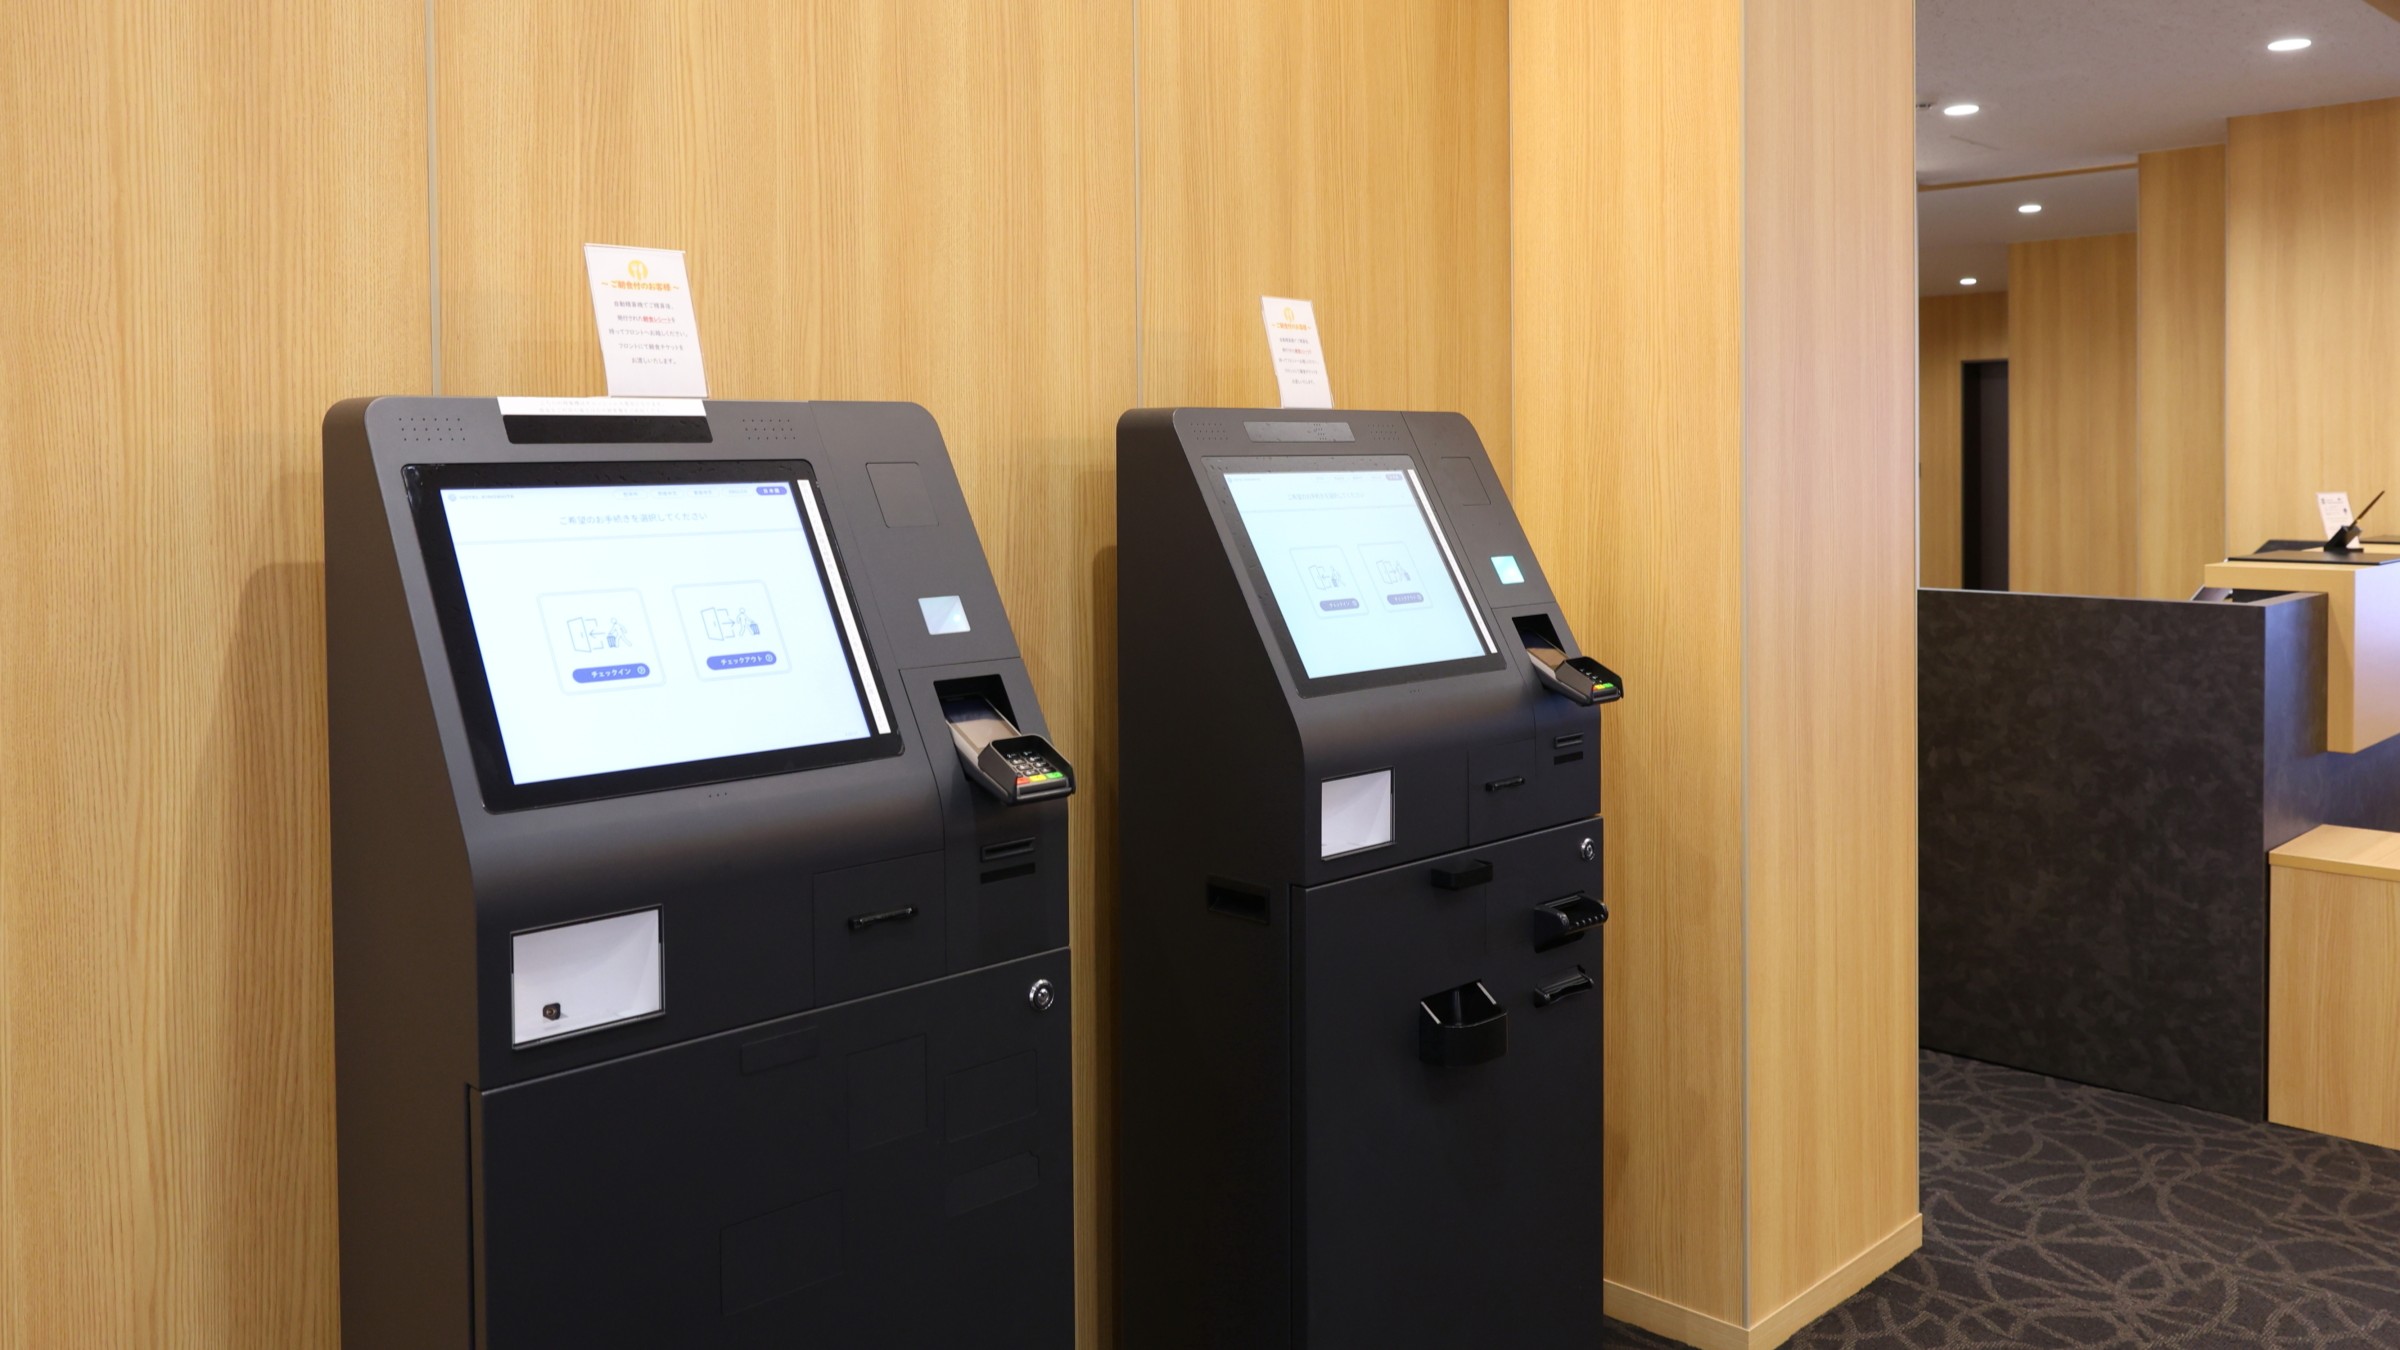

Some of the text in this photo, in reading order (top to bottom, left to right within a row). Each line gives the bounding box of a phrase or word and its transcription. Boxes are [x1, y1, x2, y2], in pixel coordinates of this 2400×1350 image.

[559, 512, 708, 526] ご希望のお手続きを選択してください
[720, 655, 763, 666] チェックアウト
[591, 668, 632, 678] チェックイン
